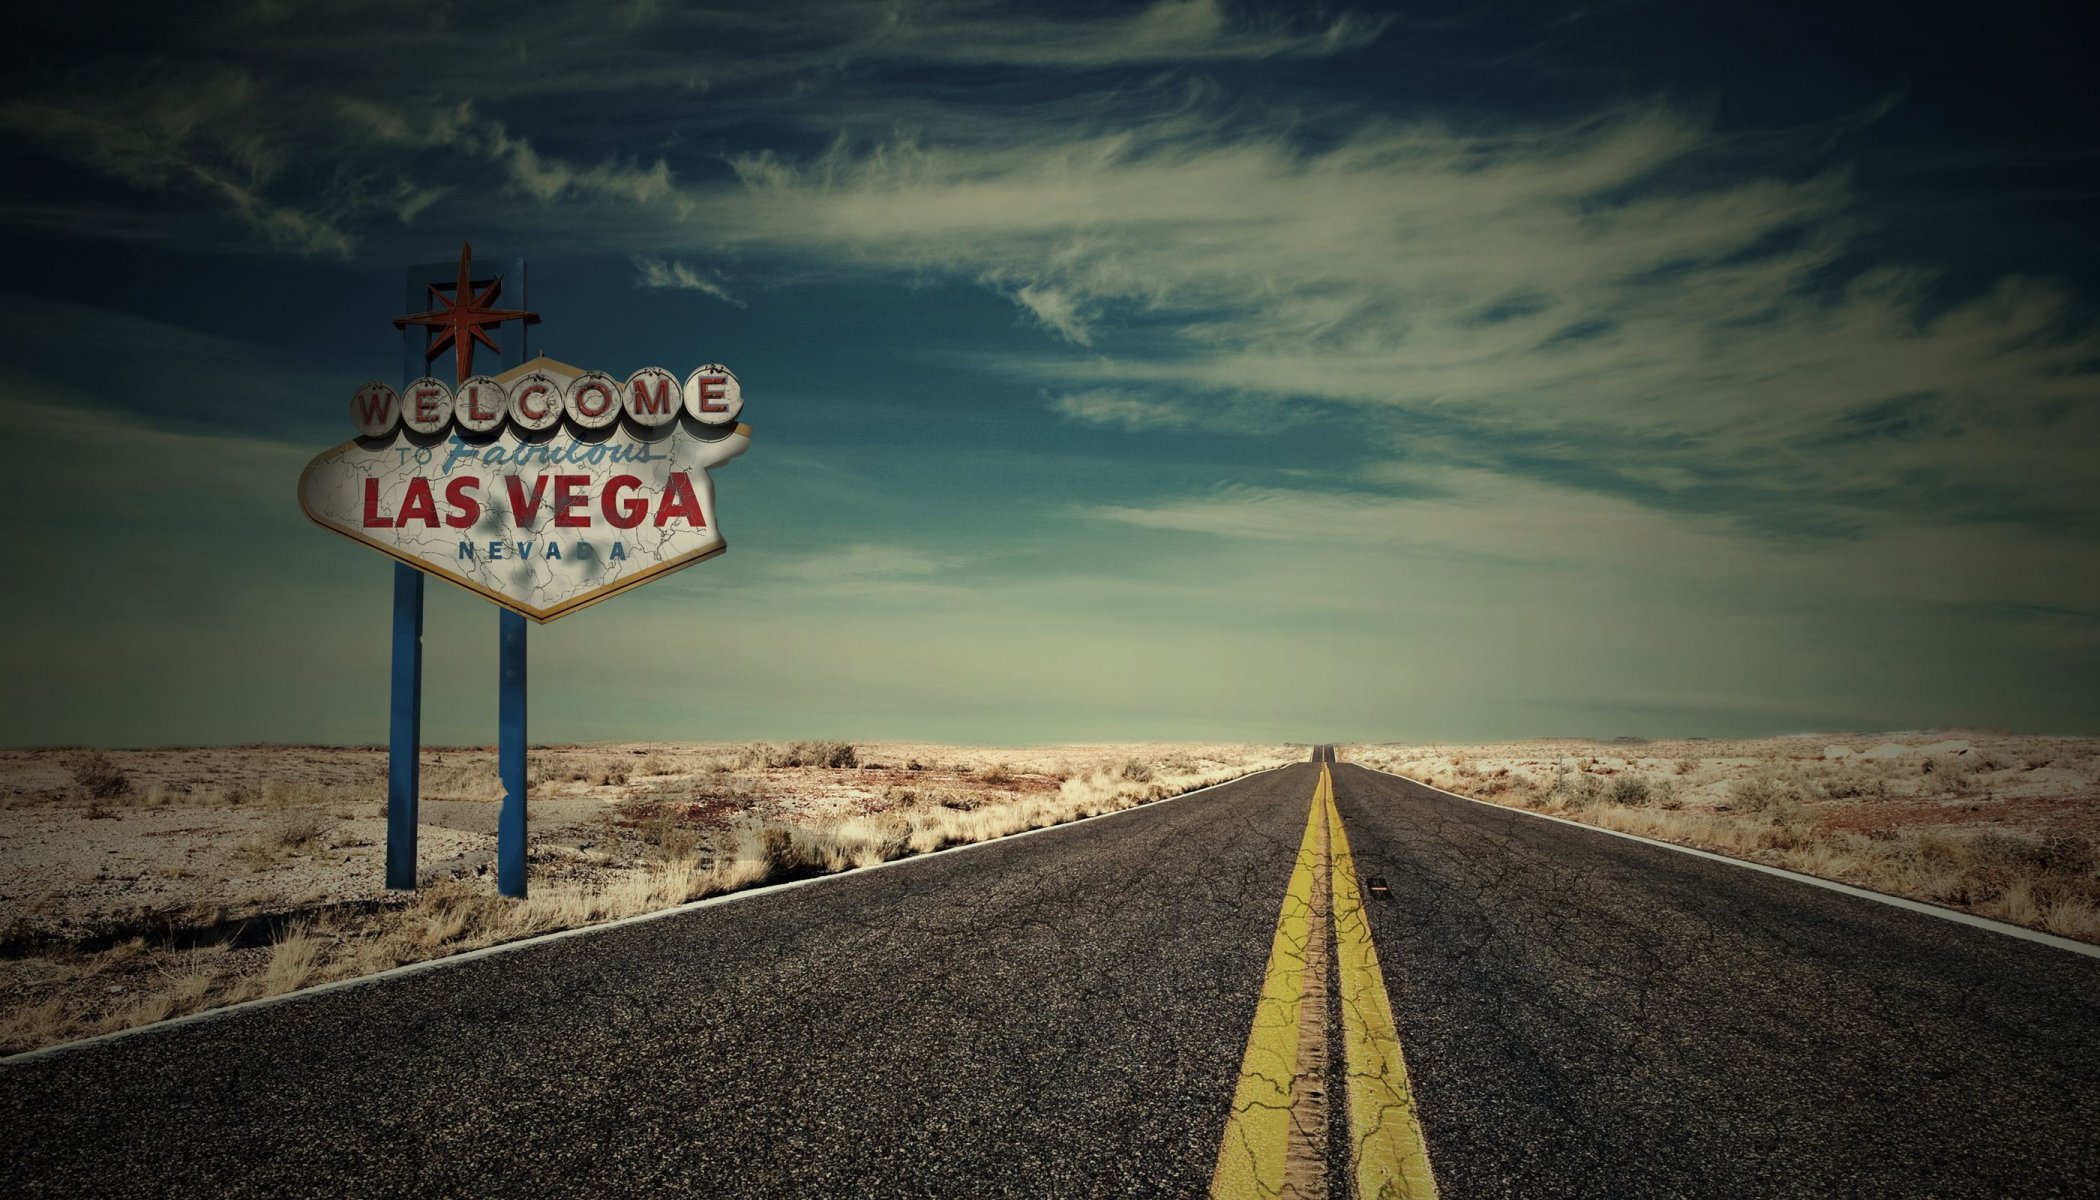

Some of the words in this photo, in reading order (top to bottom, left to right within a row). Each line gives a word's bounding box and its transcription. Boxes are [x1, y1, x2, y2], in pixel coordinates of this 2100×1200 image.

[357, 377, 729, 424] WELCOME
[396, 447, 432, 466] TO
[442, 435, 667, 475] Fabulous
[363, 475, 480, 528] LAS
[505, 472, 706, 528] VEGA
[458, 541, 626, 560] NEVADA
